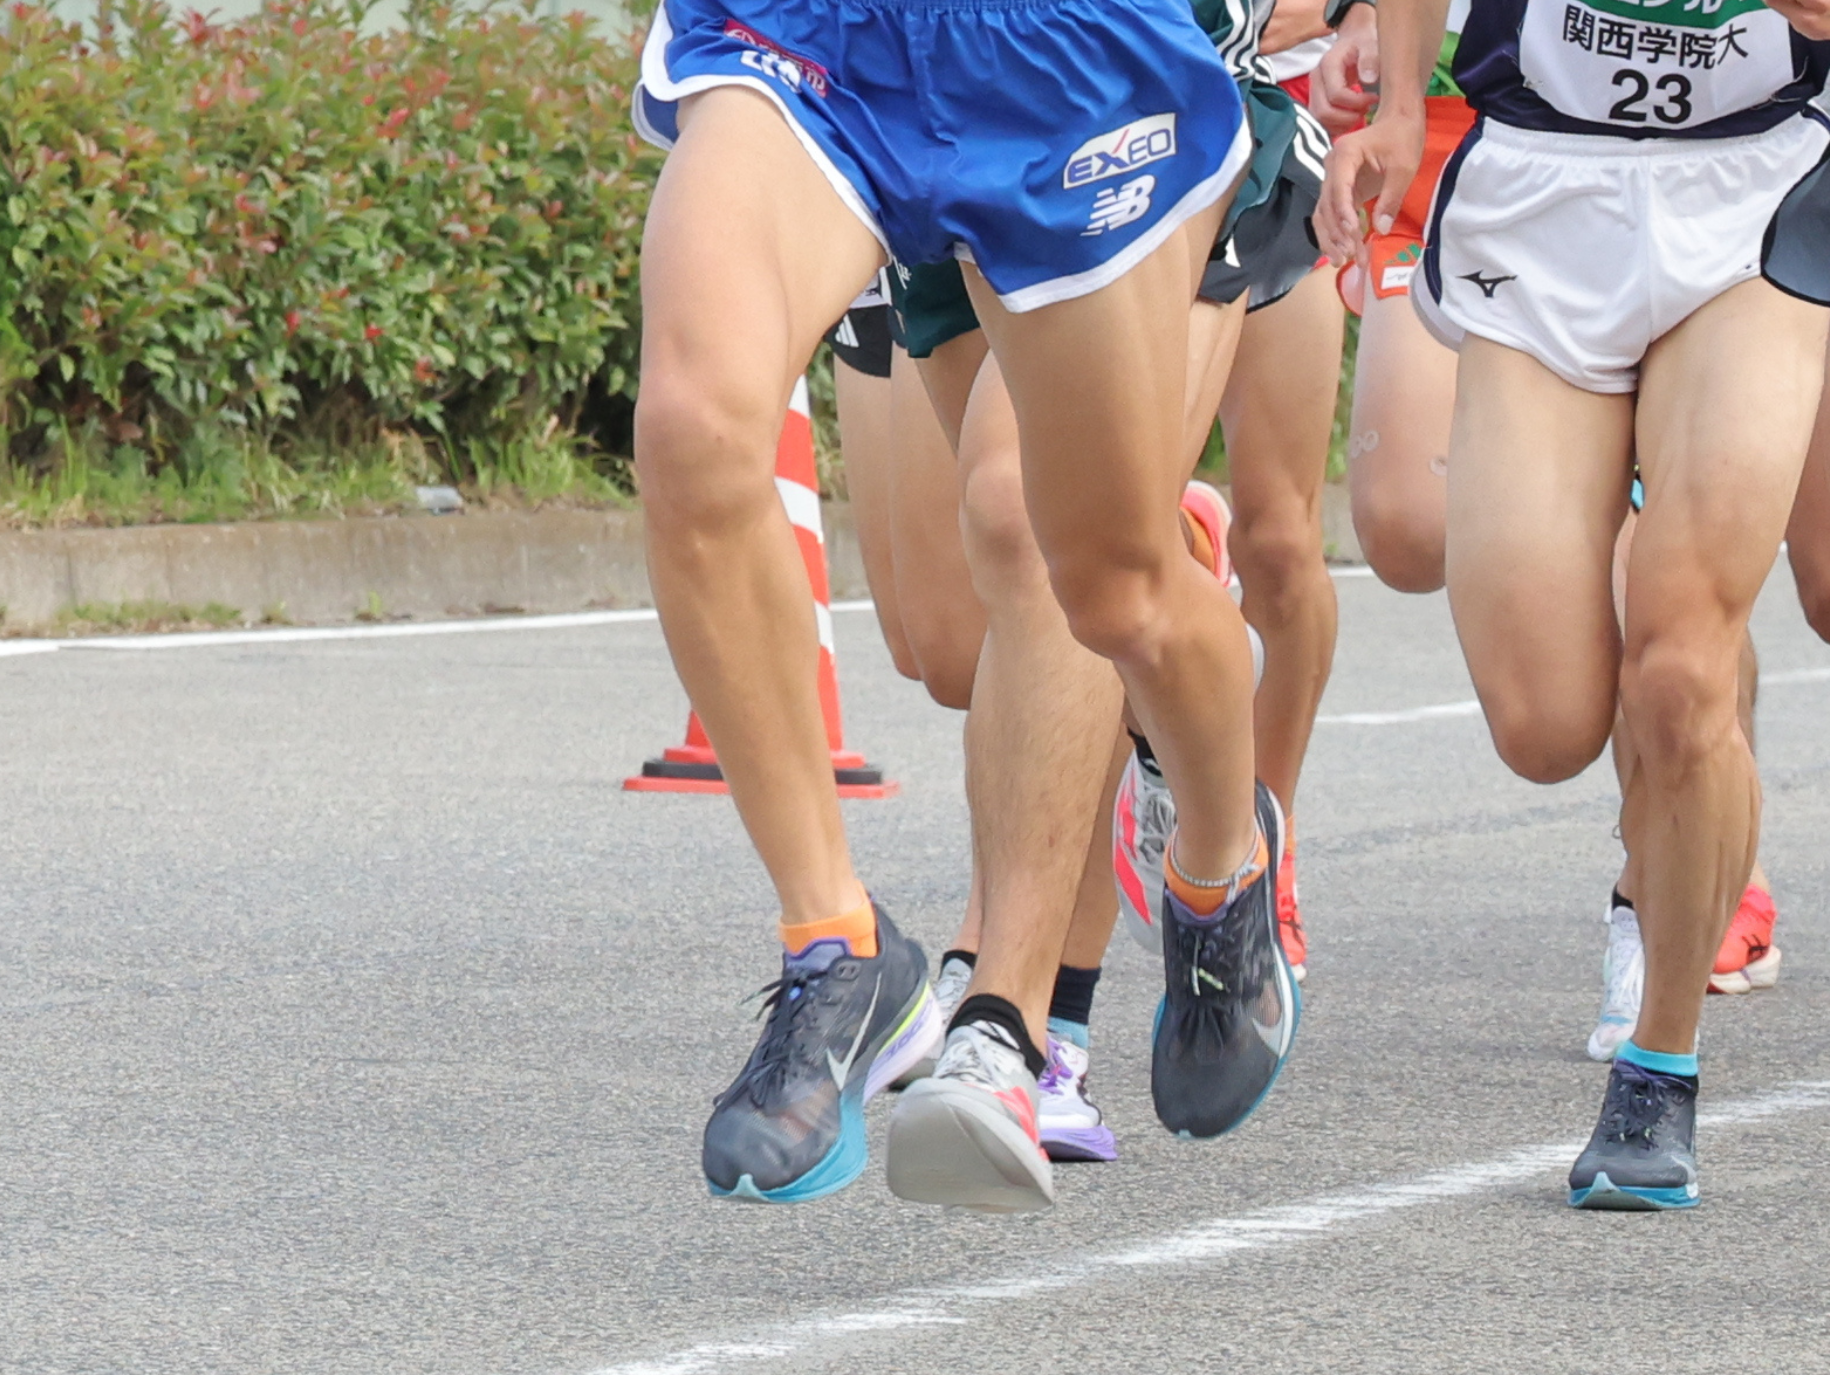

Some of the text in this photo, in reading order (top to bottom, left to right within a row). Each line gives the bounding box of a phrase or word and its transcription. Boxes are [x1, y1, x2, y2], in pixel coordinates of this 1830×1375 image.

[1562, 4, 1749, 70] 関西学院大
[1608, 68, 1693, 124] 23
[1067, 128, 1171, 184] EXEO
